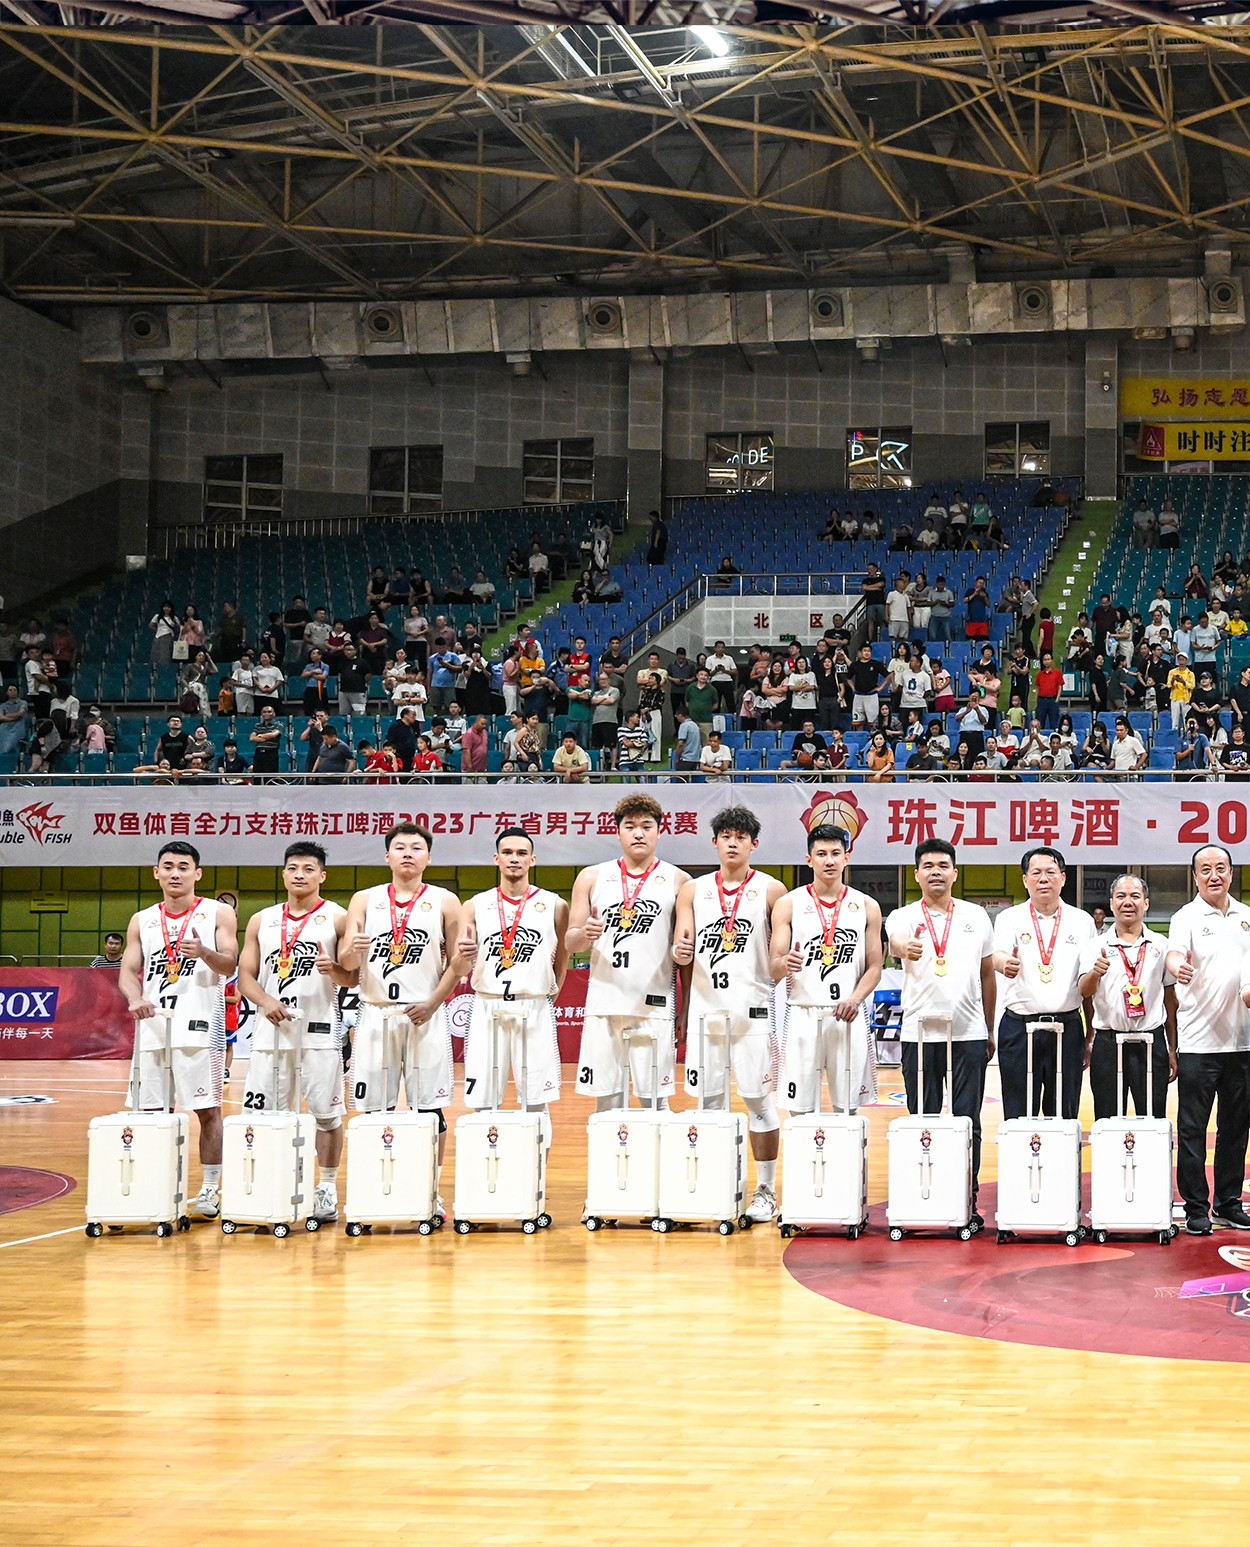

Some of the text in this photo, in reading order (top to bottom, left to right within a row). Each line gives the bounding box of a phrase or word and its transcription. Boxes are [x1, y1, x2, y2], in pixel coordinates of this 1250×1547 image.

[44, 833, 72, 844] FISH
[612, 951, 630, 968] 31
[501, 980, 512, 996] 7
[711, 971, 729, 989] 13
[388, 982, 400, 1000] 0
[829, 982, 841, 1000] 9
[0, 991, 54, 1017] OX
[160, 995, 178, 1010] 17
[0, 1027, 54, 1040] 伴每一天
[579, 1066, 593, 1085] 31
[355, 1081, 367, 1100] 0
[466, 1077, 477, 1095] 7
[787, 1081, 797, 1099] 9
[243, 1091, 266, 1110] 23
